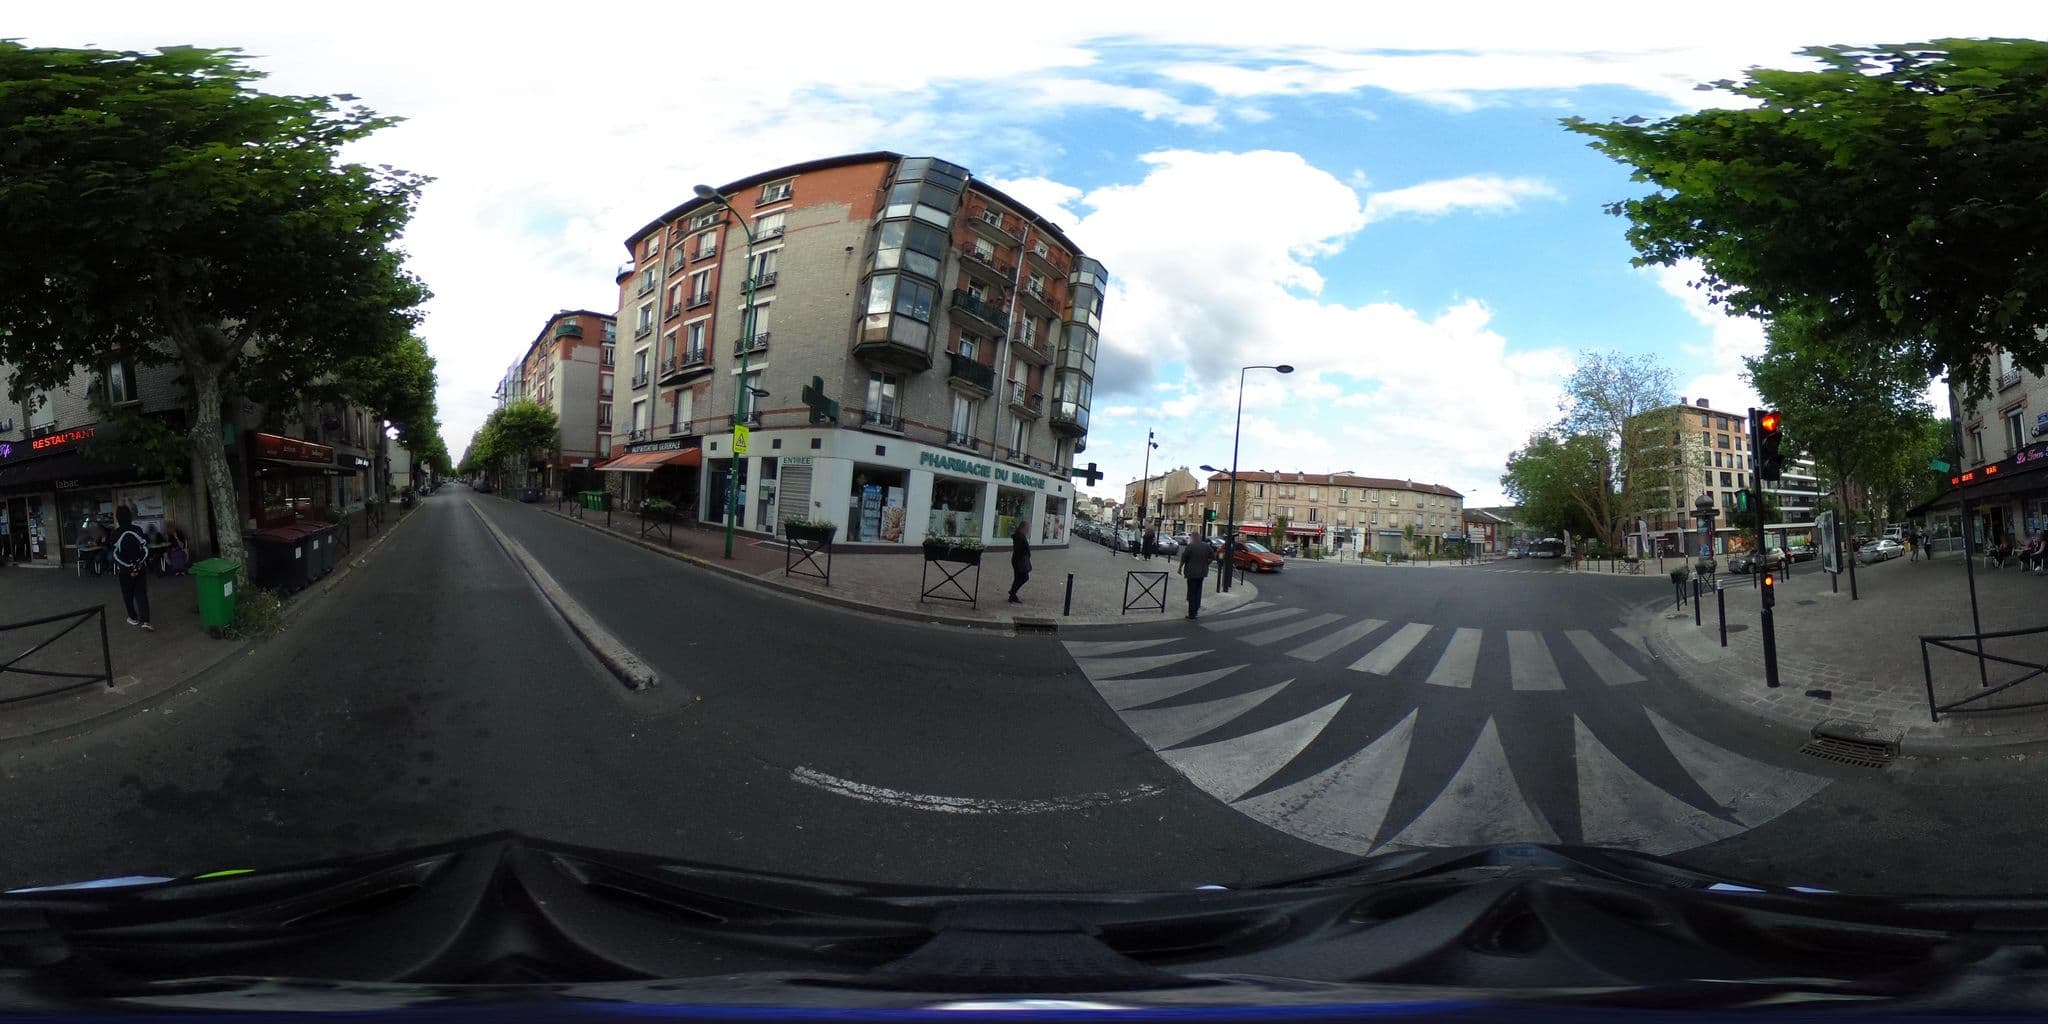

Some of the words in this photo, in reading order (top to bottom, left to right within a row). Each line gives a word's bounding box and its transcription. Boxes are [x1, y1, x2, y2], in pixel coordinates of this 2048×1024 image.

[32, 427, 96, 449] RESTAURANT
[920, 451, 991, 478] PHARMACIE
[995, 468, 1008, 482] DU
